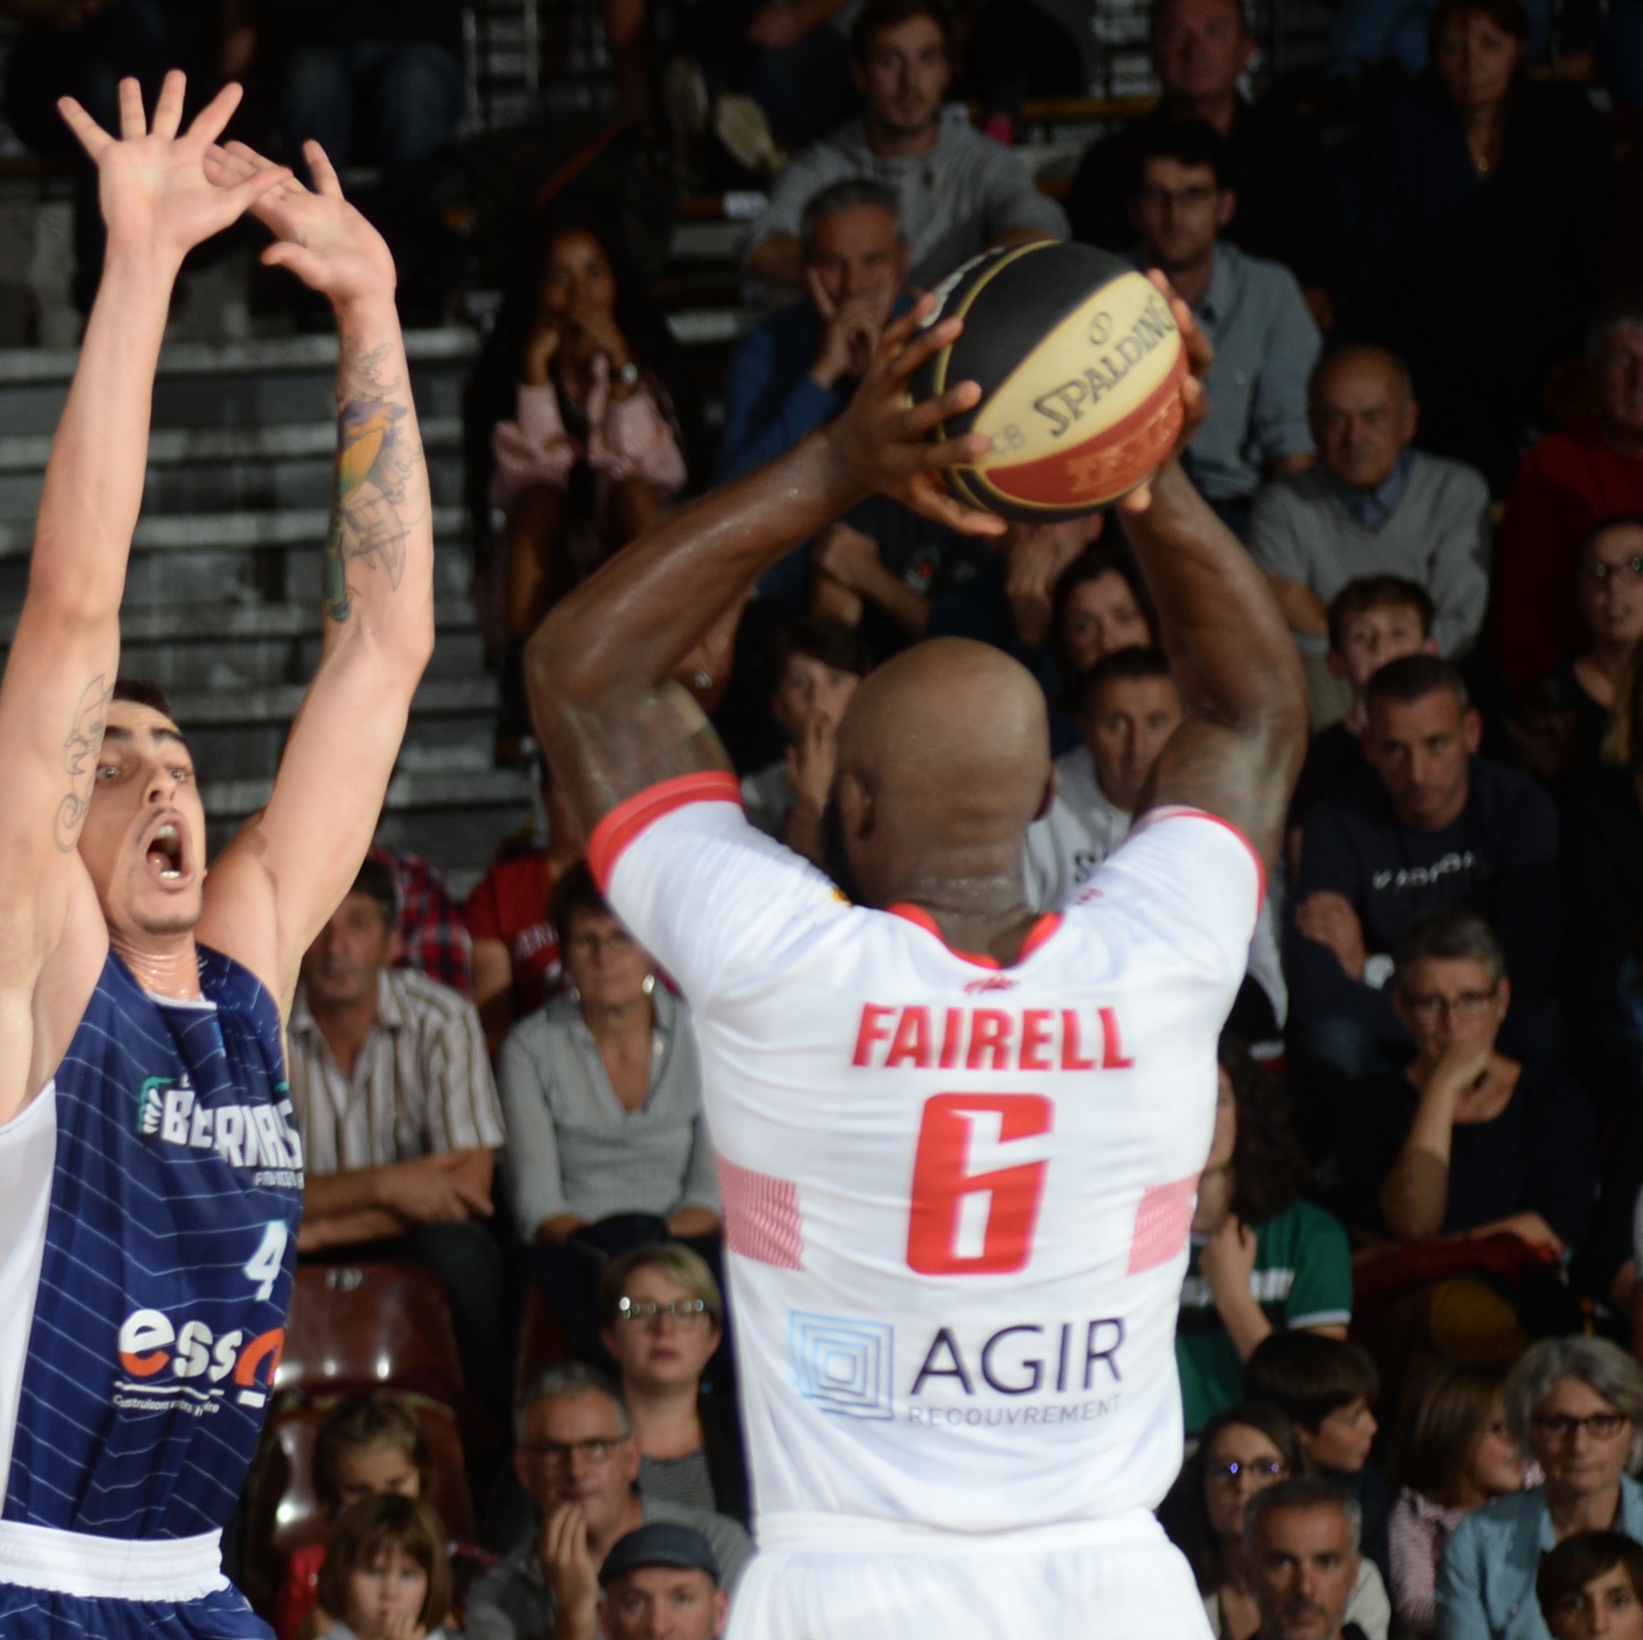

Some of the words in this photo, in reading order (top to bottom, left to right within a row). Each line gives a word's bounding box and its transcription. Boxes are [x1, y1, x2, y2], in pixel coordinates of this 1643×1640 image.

[851, 1000, 1136, 1071] FAIRELL
[905, 1090, 1056, 1277] 6
[242, 1219, 289, 1301] 4
[909, 1316, 1127, 1397] AGIR
[907, 1392, 1123, 1427] RECOUVREMENT
